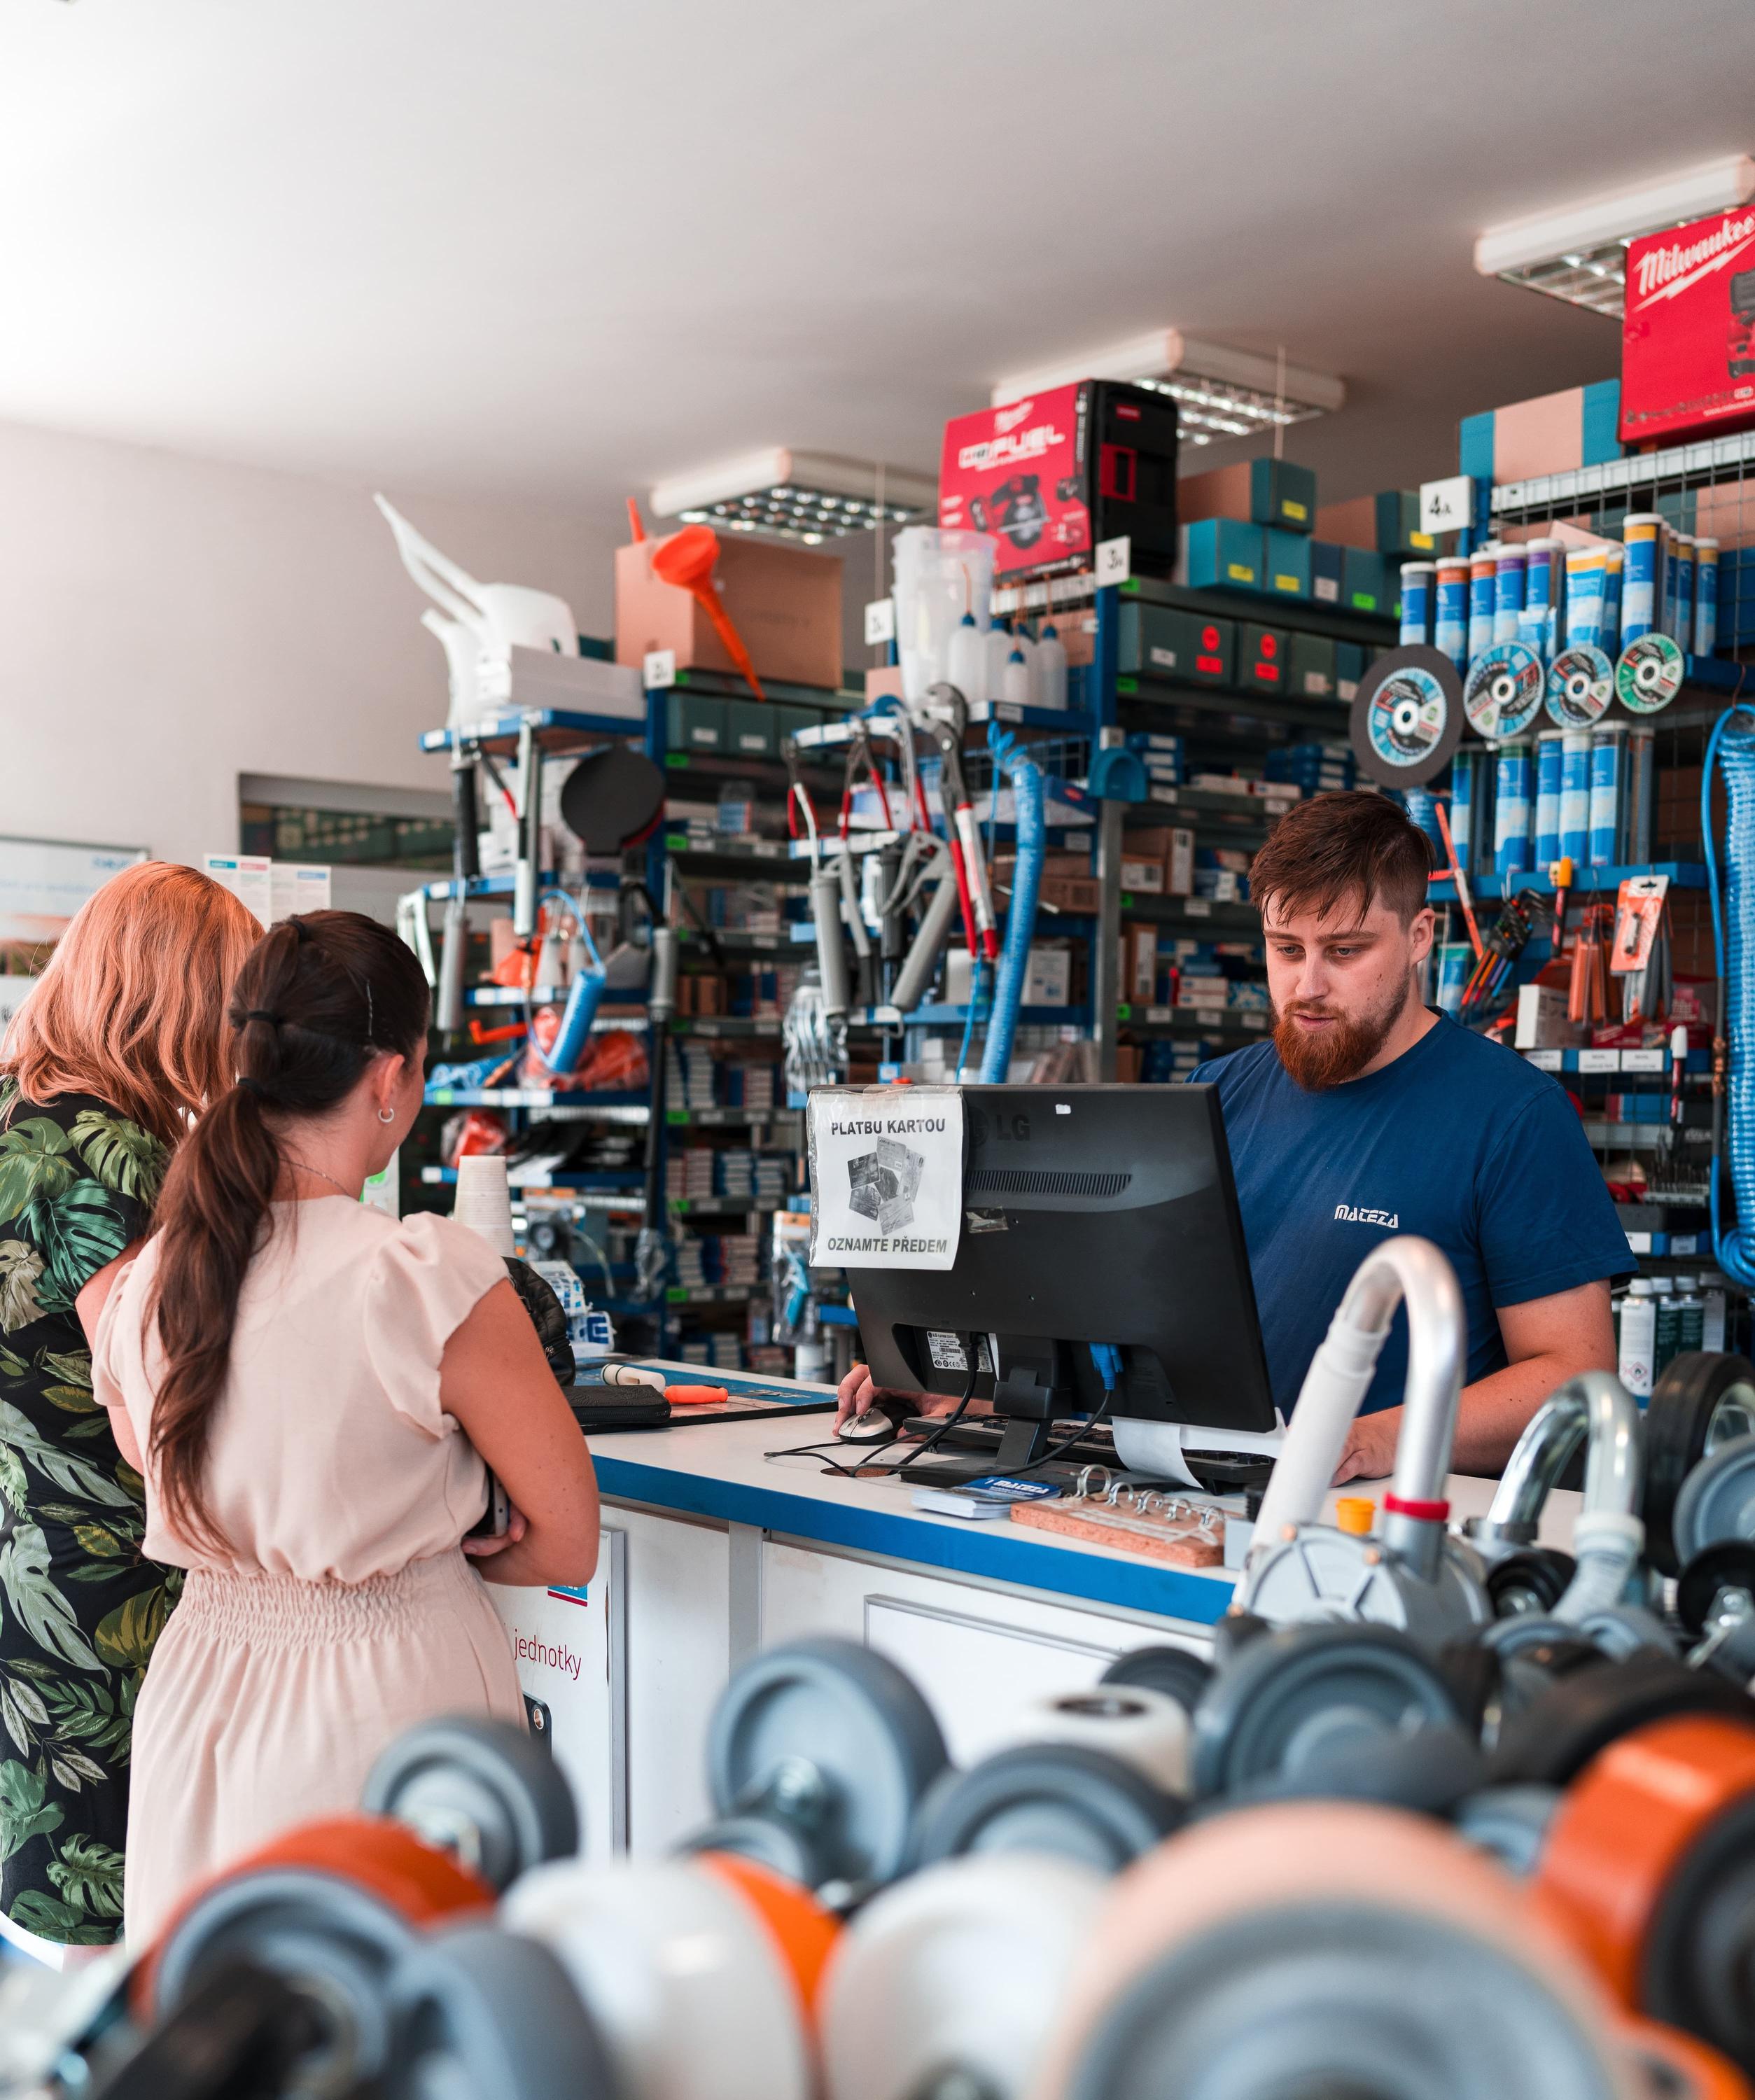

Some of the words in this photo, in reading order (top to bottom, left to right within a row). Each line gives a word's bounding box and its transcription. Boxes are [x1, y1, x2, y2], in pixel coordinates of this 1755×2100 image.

[1632, 215, 1755, 295] Milwaukee
[831, 1120, 883, 1135] PLATBU
[887, 1119, 946, 1134] KARTOU
[996, 1114, 1030, 1142] LG
[1334, 1205, 1399, 1228] MATEZA
[827, 1238, 889, 1252] OZNAMTE
[892, 1236, 948, 1253] PŘEDEM
[515, 1628, 582, 1681] jednotky
